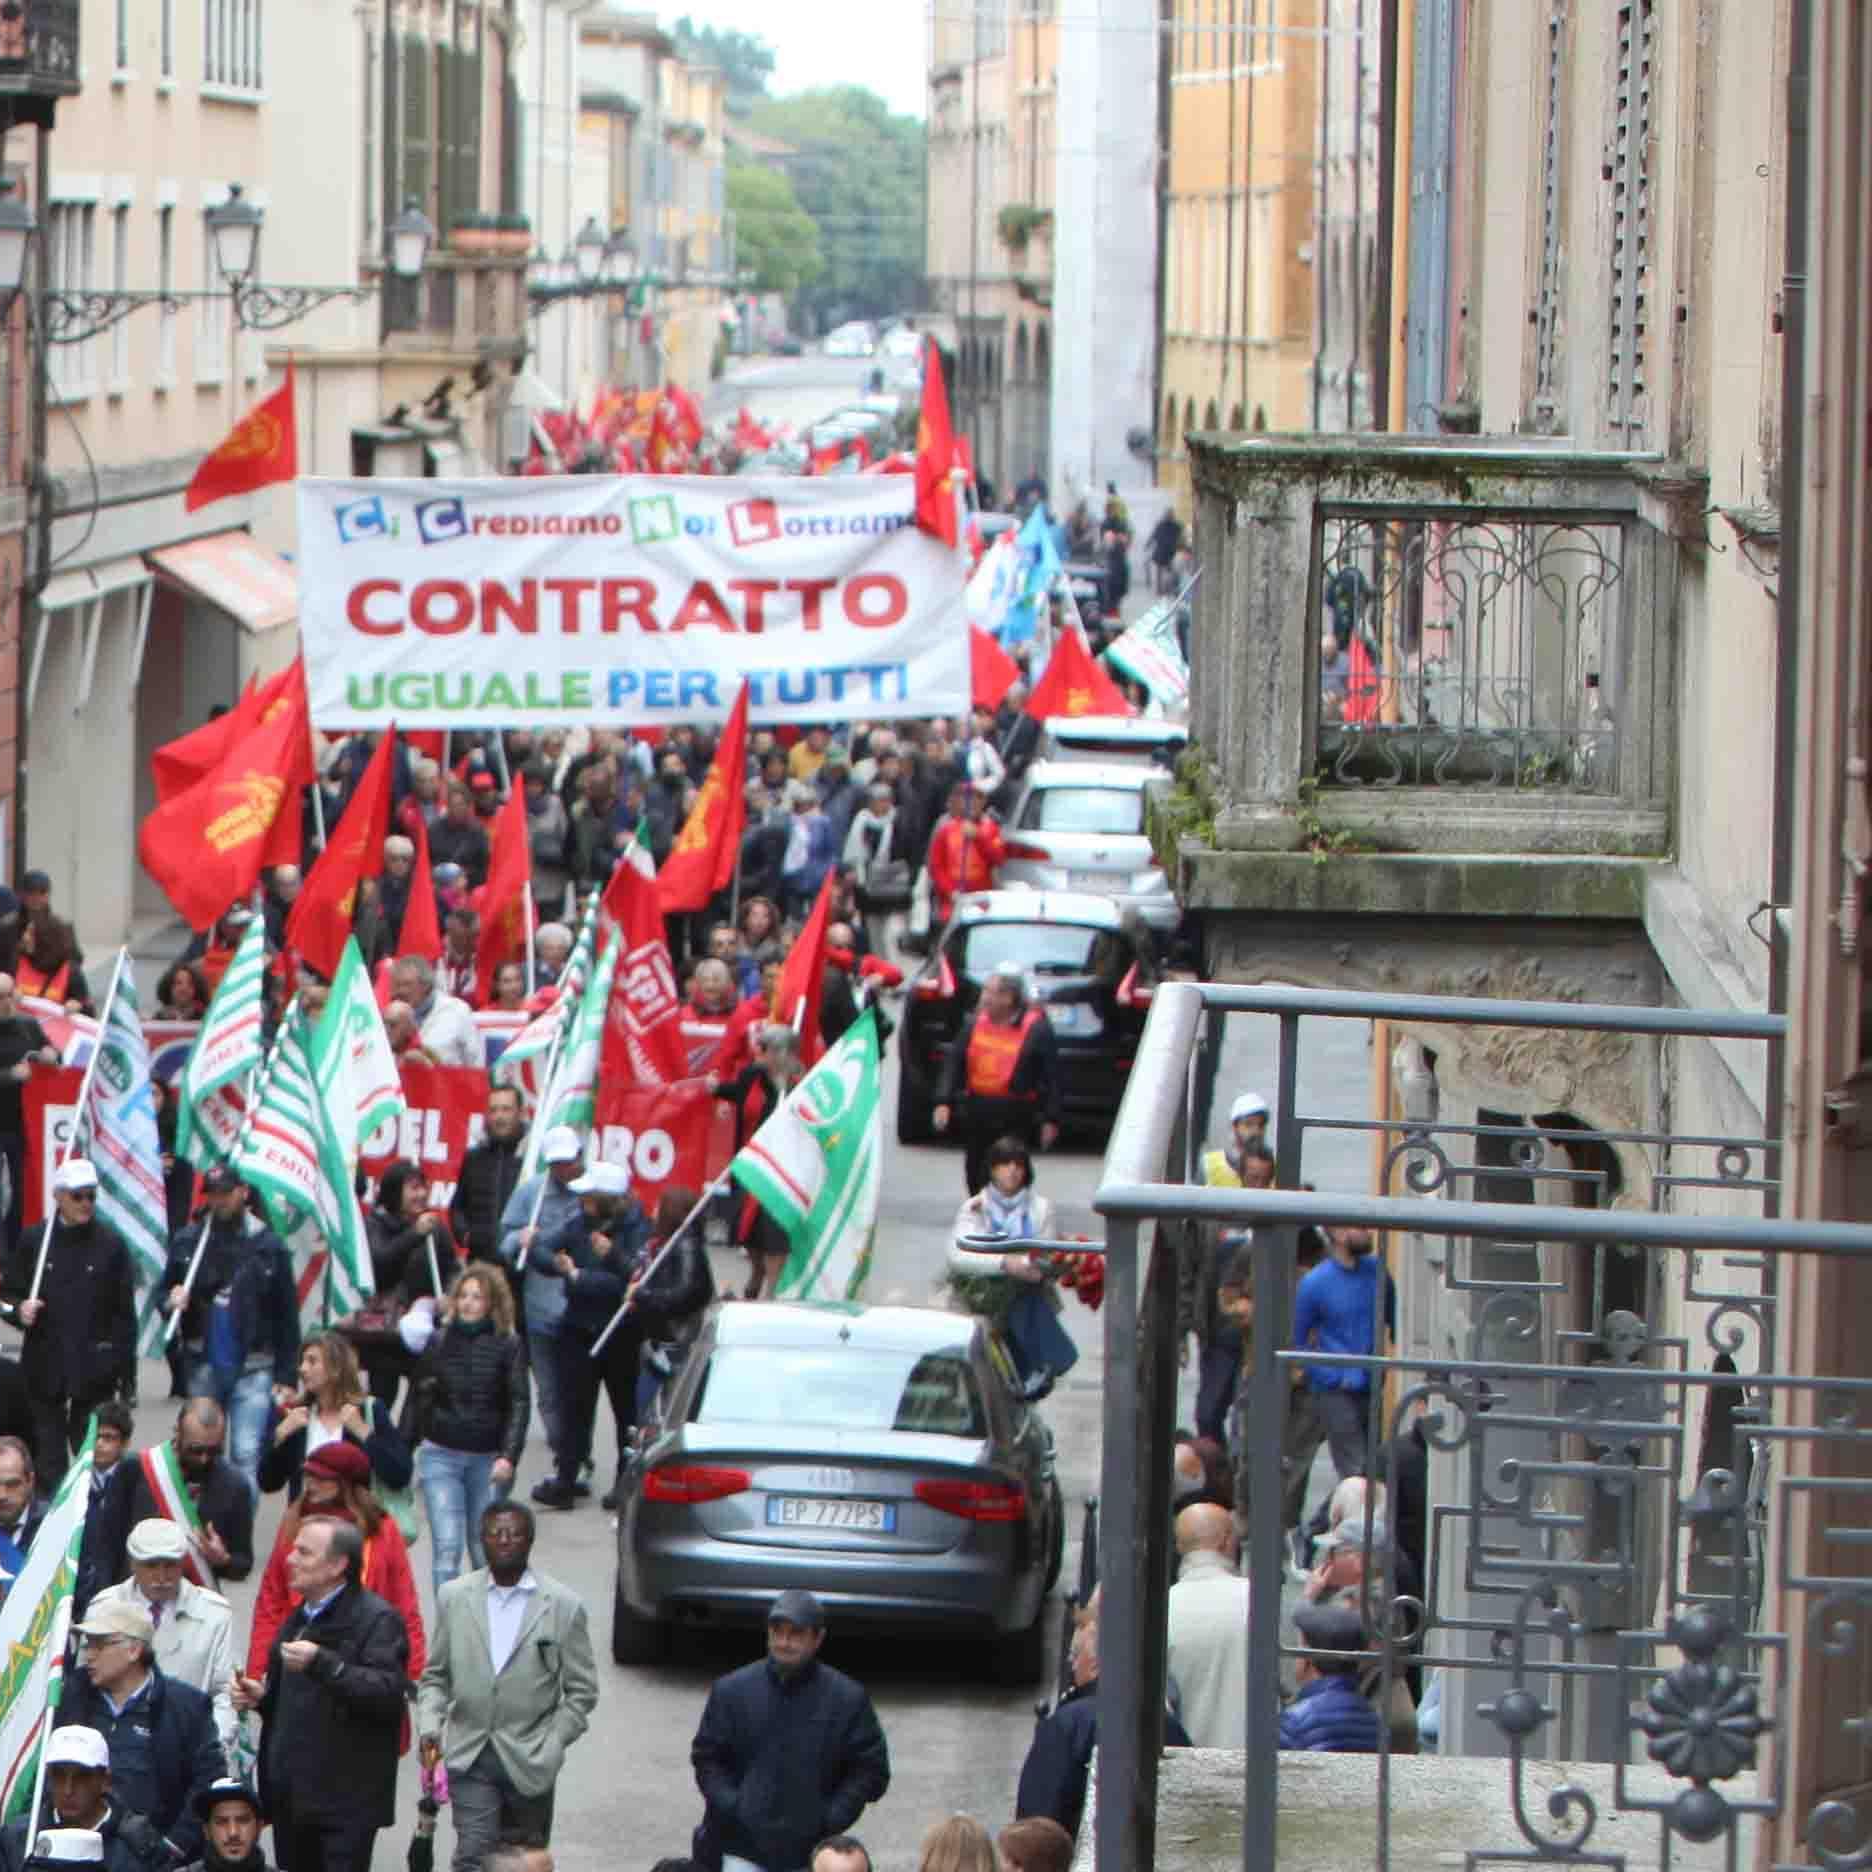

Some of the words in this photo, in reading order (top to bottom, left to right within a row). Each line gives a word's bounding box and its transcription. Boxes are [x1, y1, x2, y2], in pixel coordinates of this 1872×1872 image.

[345, 575, 909, 637] CONTRATTO
[345, 670, 592, 712] UGUALE
[607, 669, 721, 709] PER
[746, 663, 909, 706] TUTTI
[356, 1107, 448, 1164] DEL
